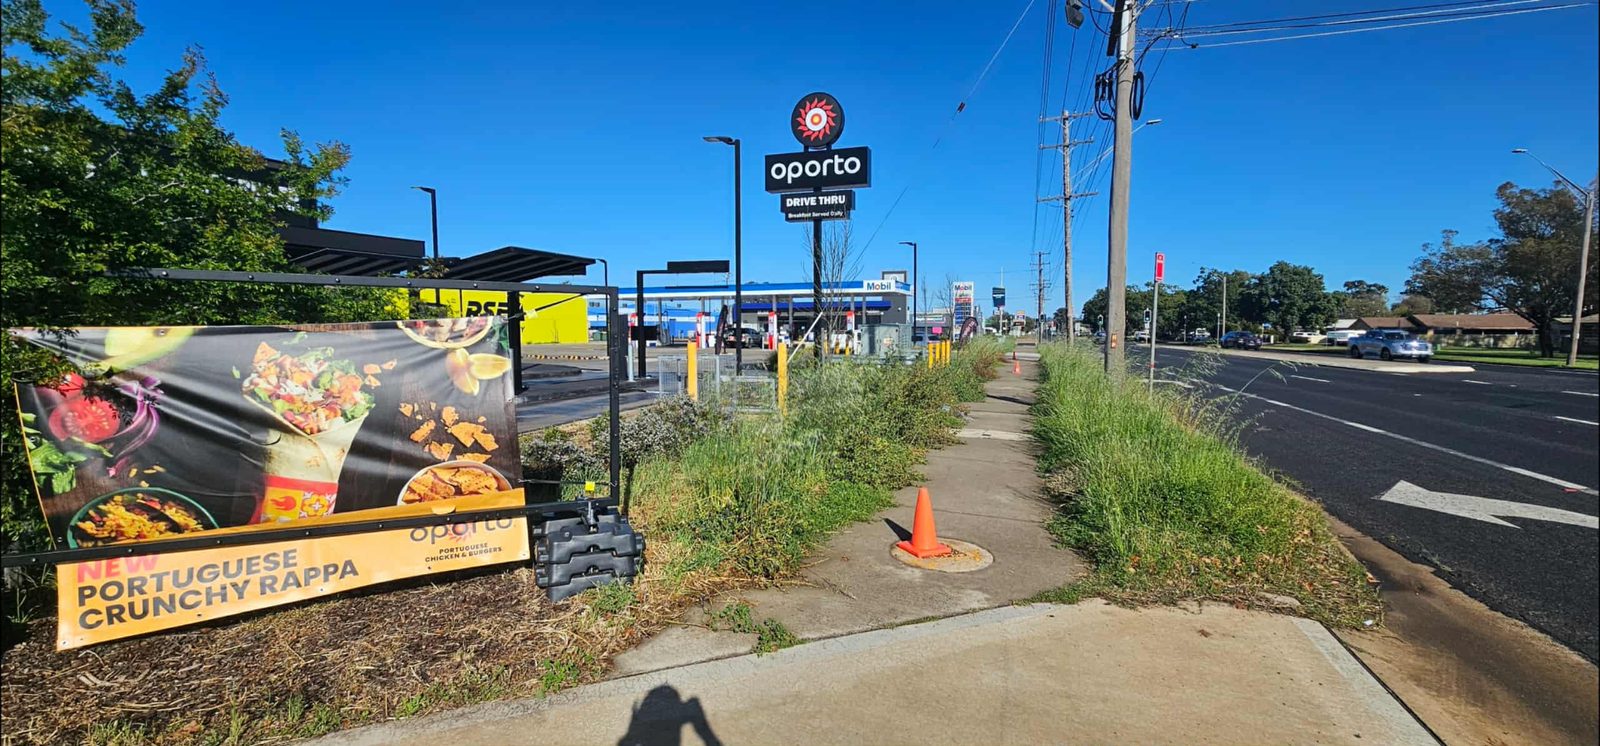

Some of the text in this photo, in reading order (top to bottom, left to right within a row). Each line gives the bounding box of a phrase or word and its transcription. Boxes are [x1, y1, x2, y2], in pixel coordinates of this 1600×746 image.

[771, 154, 861, 184] oporto
[786, 194, 846, 207] DRIVE THRU
[866, 282, 891, 291] Mobil
[425, 552, 460, 563] CHICKEN
[468, 546, 502, 557] BURGERS
[439, 542, 488, 554] PORTUGUESE
[77, 555, 159, 583] NEW
[78, 548, 297, 607] PORTUGUESE
[79, 559, 359, 630] CRUNCHY RAPPA
